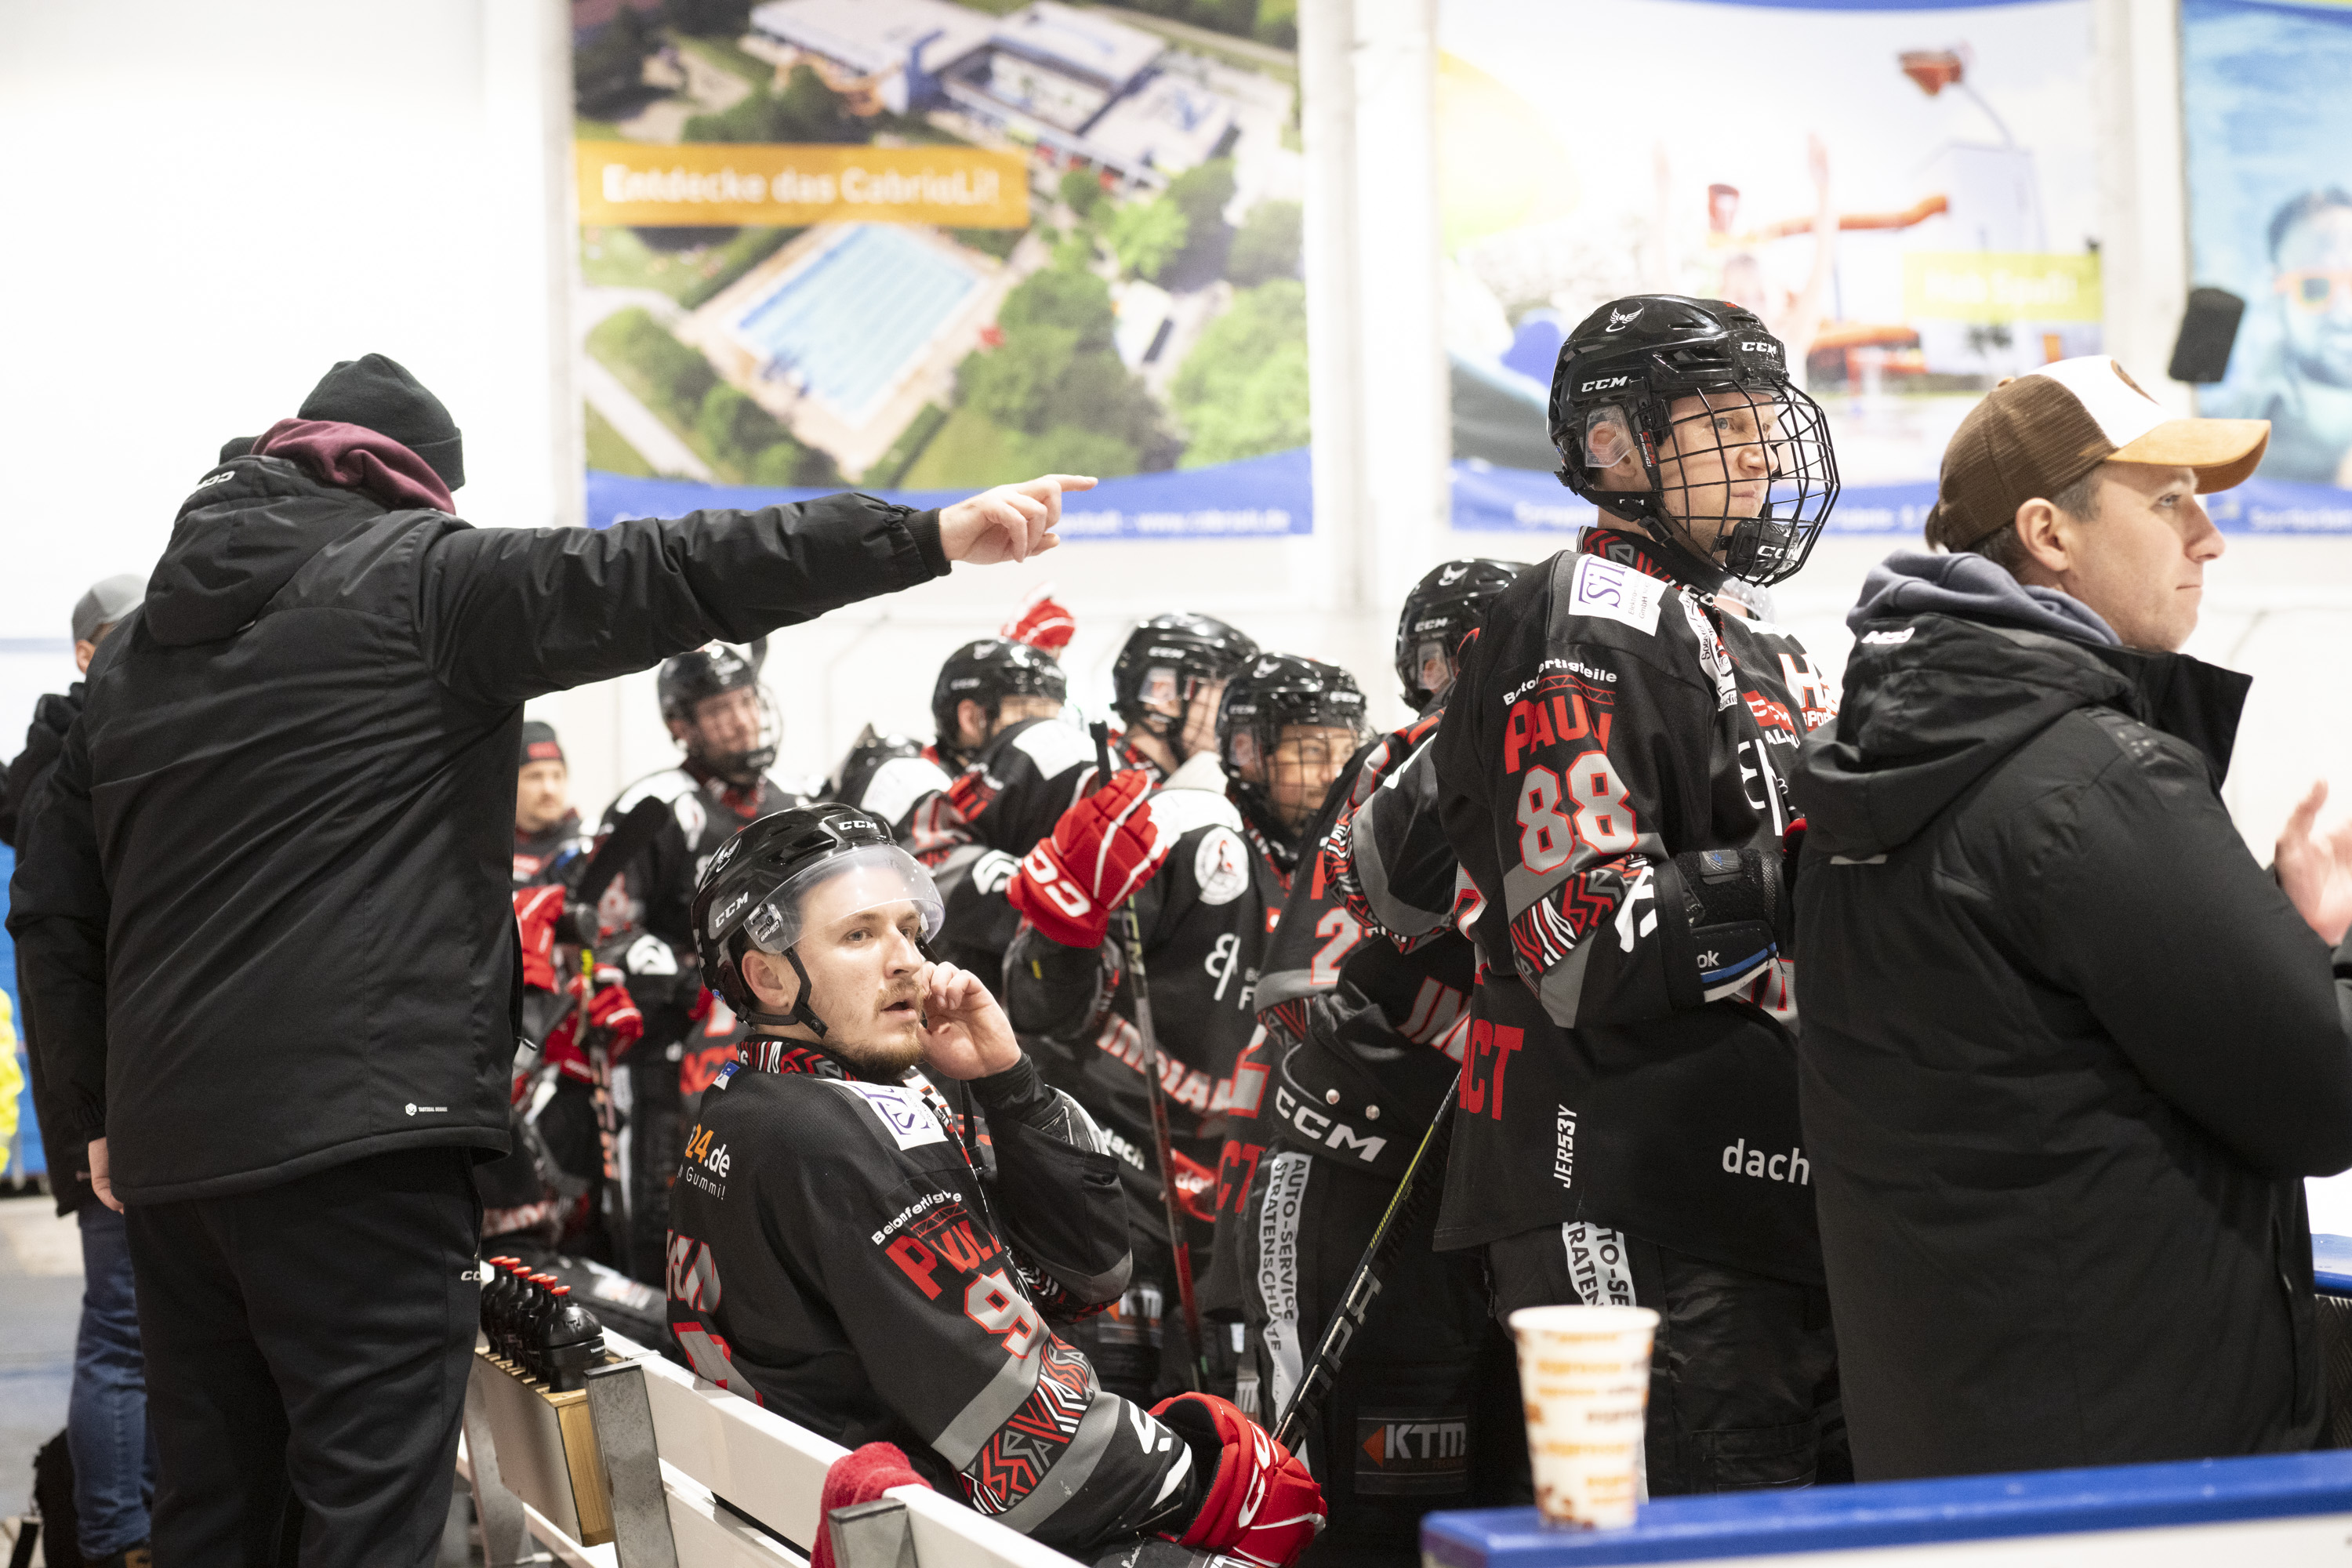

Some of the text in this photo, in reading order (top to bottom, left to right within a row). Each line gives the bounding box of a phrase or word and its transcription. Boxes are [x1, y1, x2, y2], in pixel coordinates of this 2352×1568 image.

[602, 163, 768, 204] Entdecke
[771, 166, 837, 204] das
[1741, 341, 1777, 358] CCM
[1581, 376, 1628, 393] CCM
[1642, 431, 1657, 464] CCM
[1639, 596, 1649, 619] GmbH
[838, 819, 878, 831] CCM
[1516, 750, 1640, 877] 88
[714, 891, 749, 928] CCM
[1275, 1085, 1388, 1163] CCM
[1722, 1137, 1810, 1185] dach
[685, 1166, 727, 1201] Gummi!
[1278, 1157, 1307, 1322] AUTO-SERVICE
[1385, 1422, 1467, 1459] KTM
